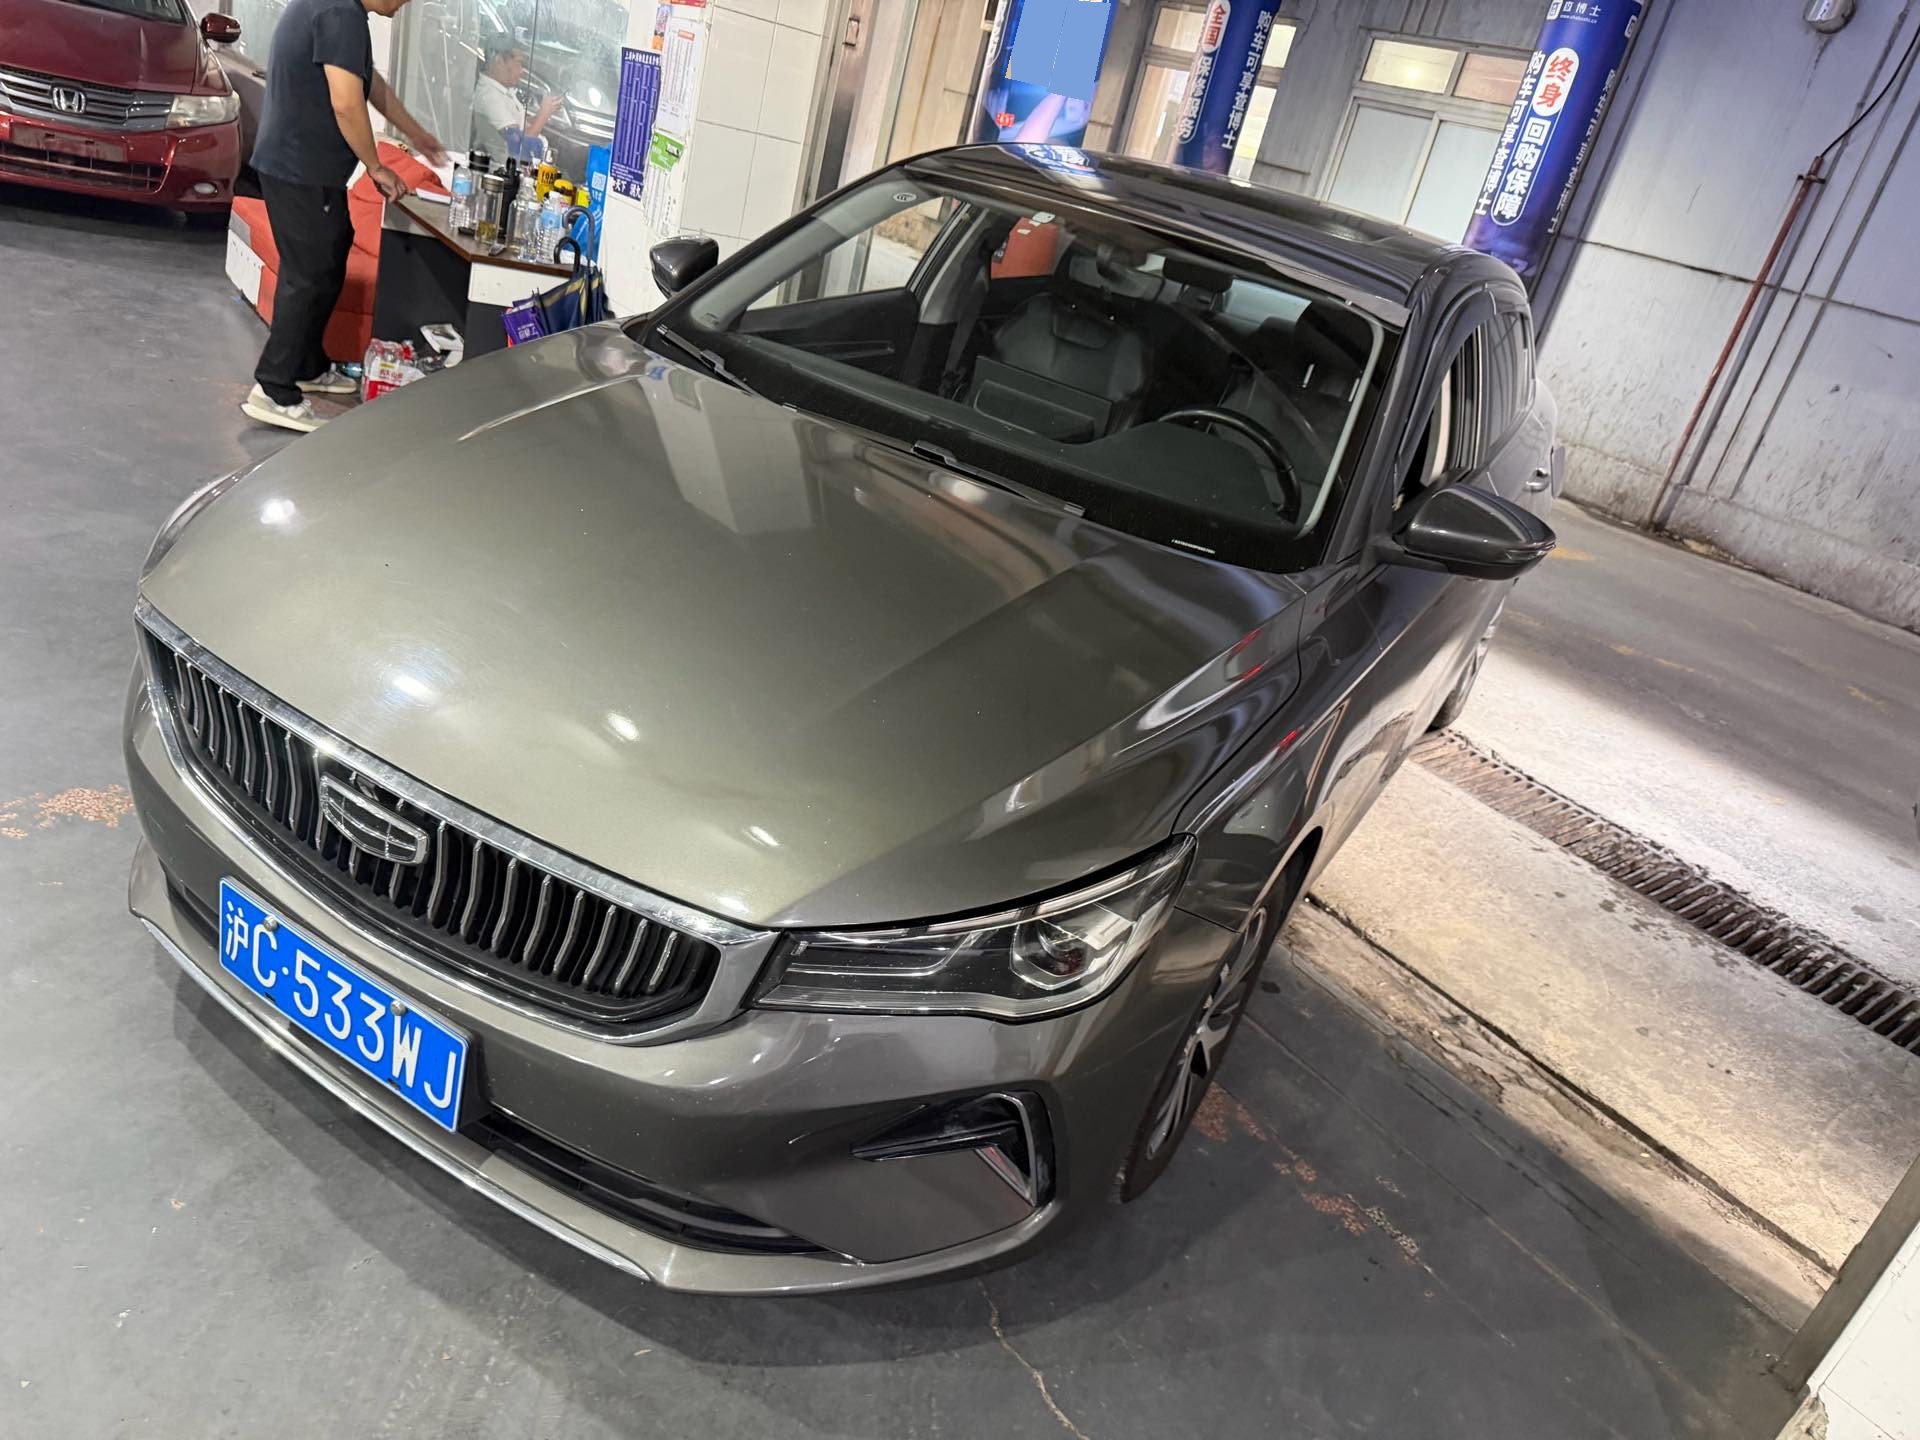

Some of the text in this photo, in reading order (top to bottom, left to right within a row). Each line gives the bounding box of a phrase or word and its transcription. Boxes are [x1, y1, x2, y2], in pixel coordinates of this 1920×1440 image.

[1203, 4, 1227, 47] 全国
[1221, 10, 1272, 149] 购车可享查博士
[1475, 50, 1546, 216] 购车可享查博士
[1494, 55, 1575, 220] 终身 回购保障
